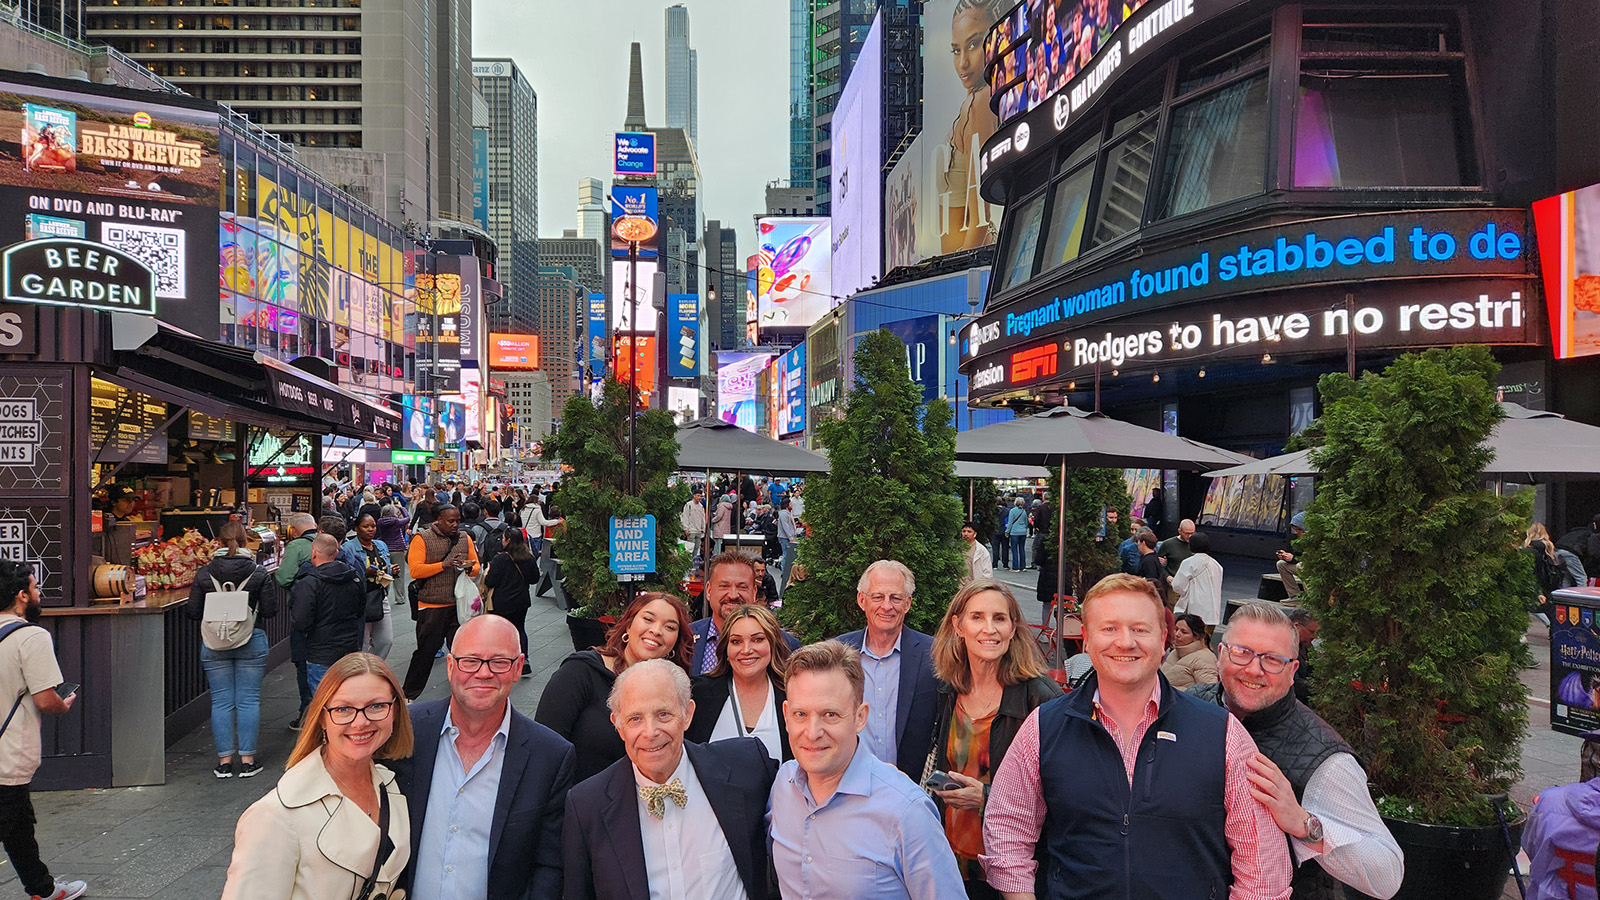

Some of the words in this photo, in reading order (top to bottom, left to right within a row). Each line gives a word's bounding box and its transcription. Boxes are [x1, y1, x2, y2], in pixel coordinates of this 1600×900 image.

[1071, 86, 1088, 112] NBA
[1087, 40, 1122, 100] PLAYOFFS
[1129, 0, 1195, 54] CONTINUE
[108, 124, 177, 145] LAWMEN
[617, 138, 629, 147] We
[81, 133, 130, 161] BASS
[132, 141, 201, 169] REEVES
[617, 146, 649, 154] Advocate
[991, 137, 1012, 162] ESPN
[1016, 130, 1029, 144] abc
[131, 162, 143, 170] DVD
[617, 160, 644, 169] Change
[472, 138, 484, 208] TIMES
[639, 192, 646, 203] 1
[29, 195, 50, 211] ON
[54, 198, 82, 214] DVD
[86, 201, 115, 217] AND
[45, 247, 119, 277] BEER
[358, 248, 378, 275] THE
[1006, 296, 1061, 337] Pregnant
[1062, 280, 1125, 318] woman
[1130, 252, 1209, 300] found
[1218, 225, 1395, 281] stabbed
[1408, 226, 1456, 261] to
[1469, 221, 1521, 260] de
[20, 273, 141, 305] GARDEN
[0, 312, 23, 347] S
[978, 321, 1000, 346] NEWS
[1011, 342, 1058, 383] ESPN
[1074, 329, 1163, 367] Rodgers
[1168, 321, 1201, 350] to
[1212, 313, 1310, 346] have
[1324, 306, 1384, 336] no
[1399, 291, 1522, 332] restri
[278, 381, 304, 402] HOTDOGS
[307, 390, 319, 407] BEER
[322, 396, 334, 412] WINE
[0, 425, 36, 439] ICHES
[1, 446, 26, 460] NIS
[614, 518, 648, 529] BEER
[0, 525, 20, 539] ER
[614, 529, 643, 540] AND
[1, 546, 20, 560] NE
[614, 540, 649, 551] WINE
[614, 551, 650, 562] AREA
[1560, 644, 1581, 660] Harry
[1562, 661, 1571, 669] THE
